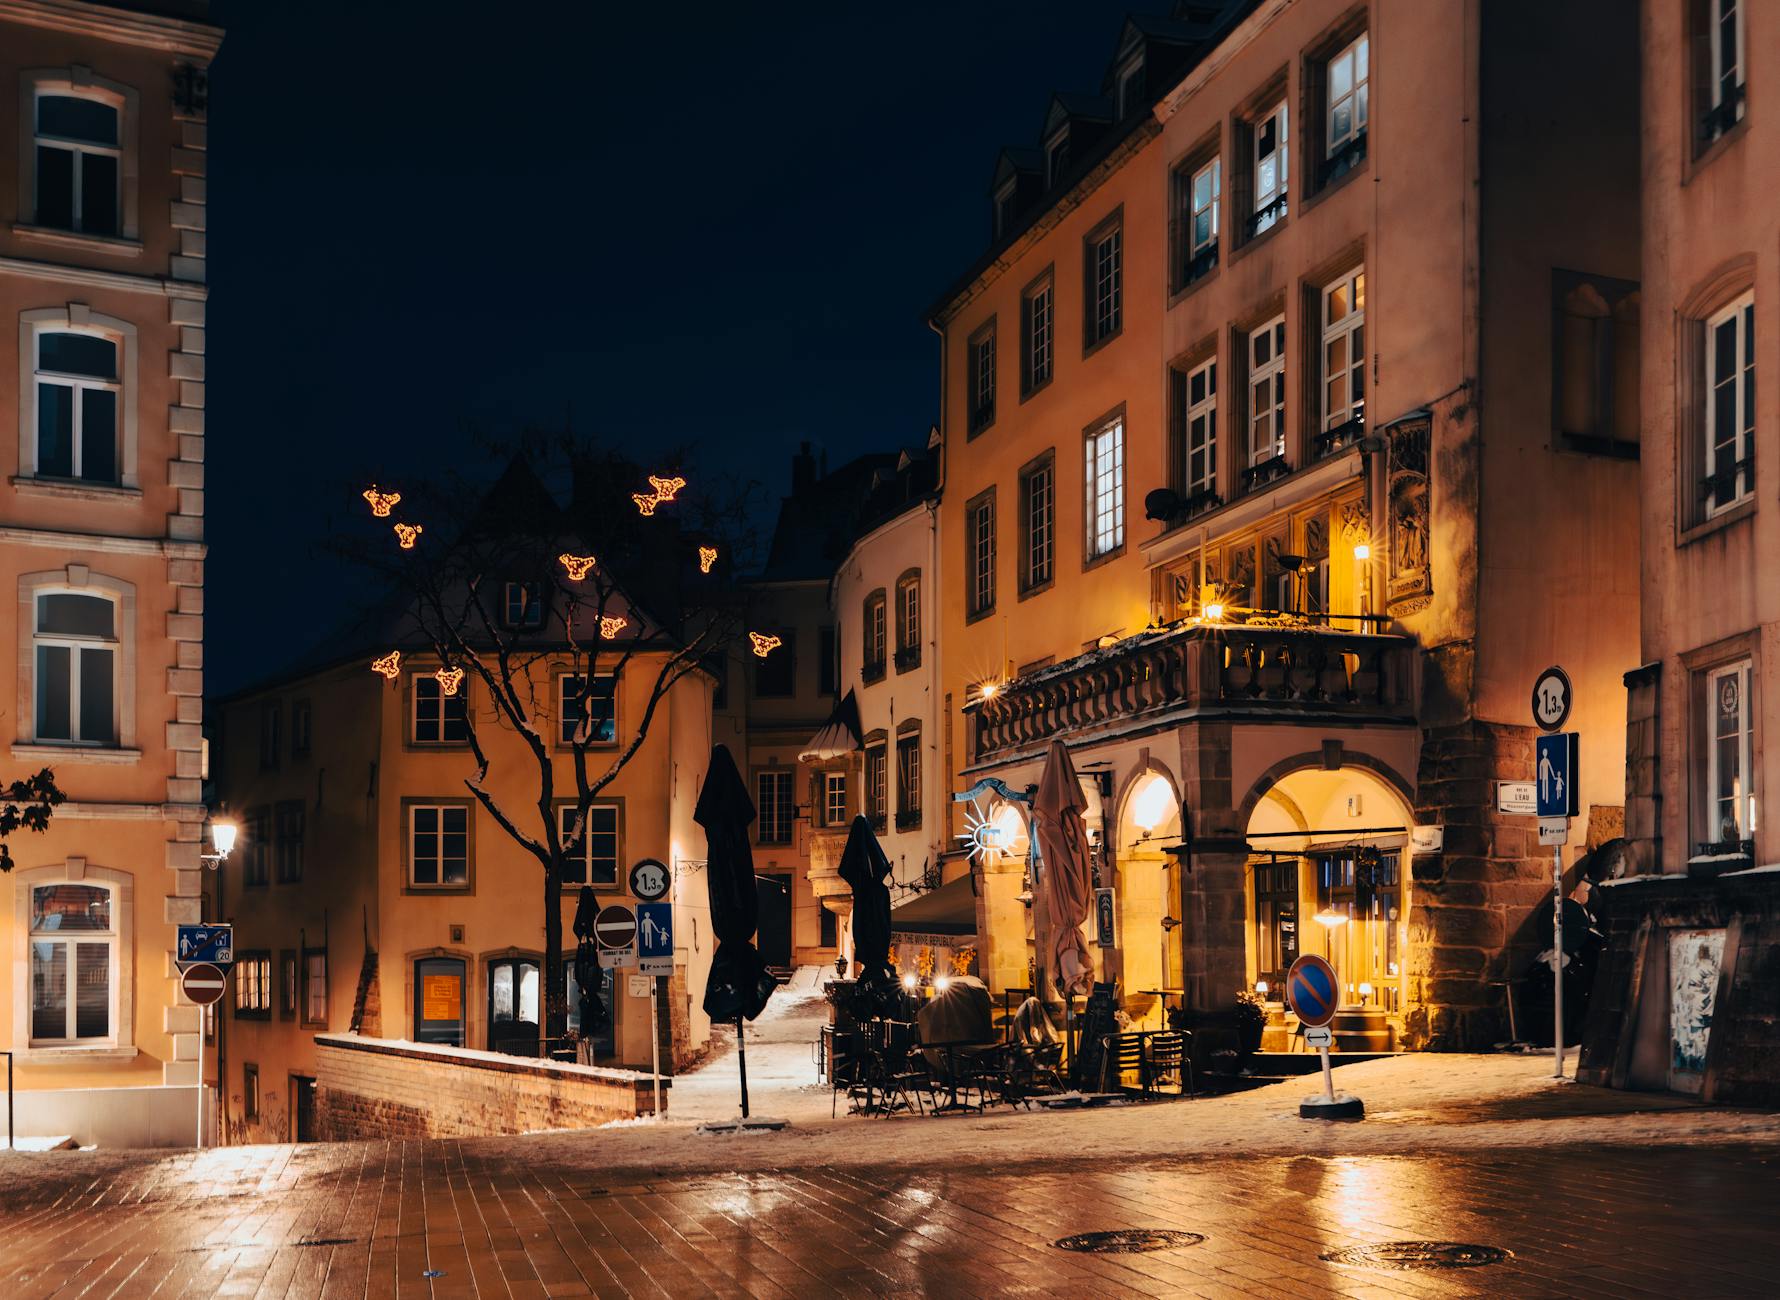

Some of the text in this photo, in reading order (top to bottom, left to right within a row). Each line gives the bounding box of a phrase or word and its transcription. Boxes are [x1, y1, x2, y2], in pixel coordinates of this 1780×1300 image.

[904, 934, 914, 944] THE
[915, 935, 928, 944] WINE
[929, 936, 954, 947] REPUBLIC
[220, 952, 230, 960] 20
